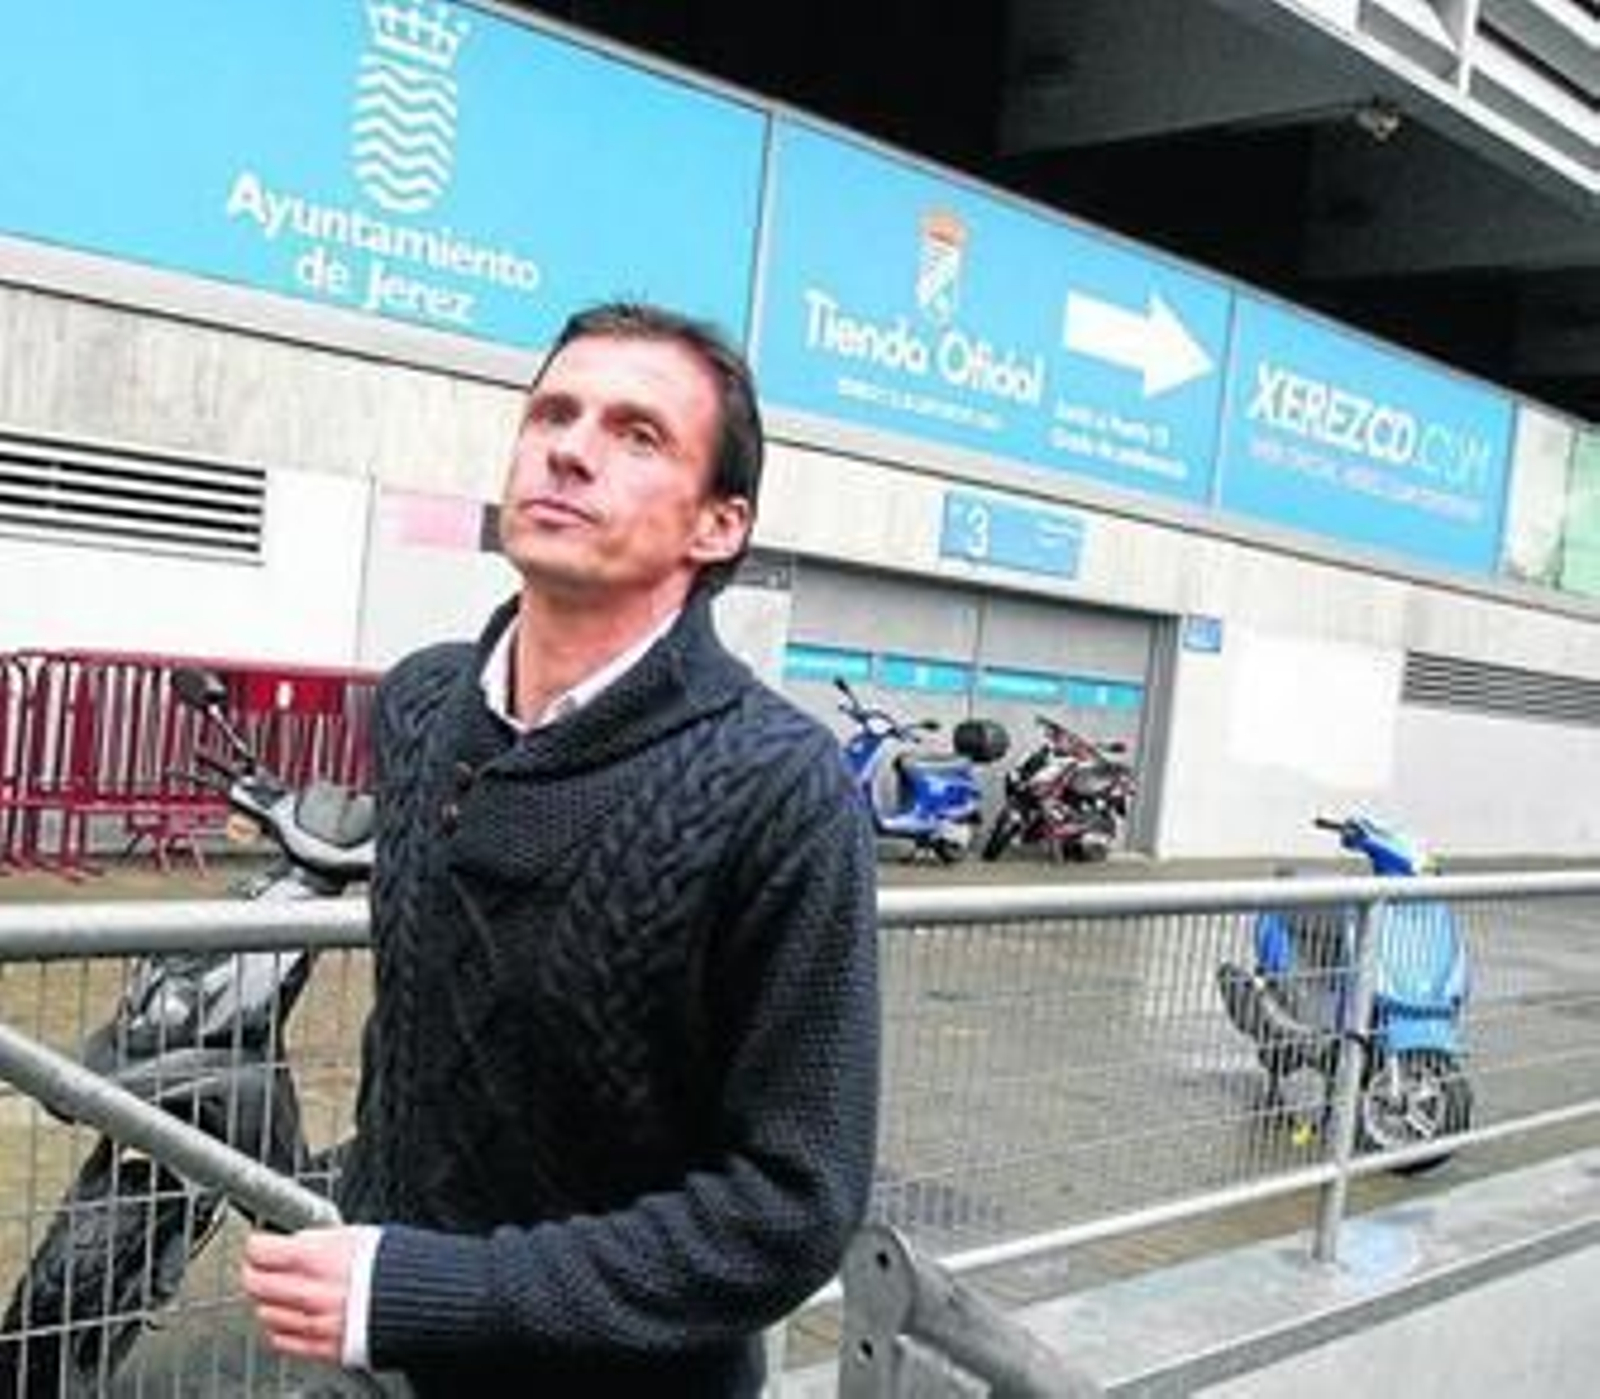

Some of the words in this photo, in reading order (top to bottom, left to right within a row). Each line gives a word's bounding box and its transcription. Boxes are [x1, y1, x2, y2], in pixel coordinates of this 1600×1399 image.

[227, 172, 539, 291] Ayuntamiento
[296, 247, 348, 294] de
[364, 258, 475, 323] Jerez
[804, 288, 928, 376] Tienda
[937, 330, 1045, 406] Oficial
[965, 506, 988, 559] 3
